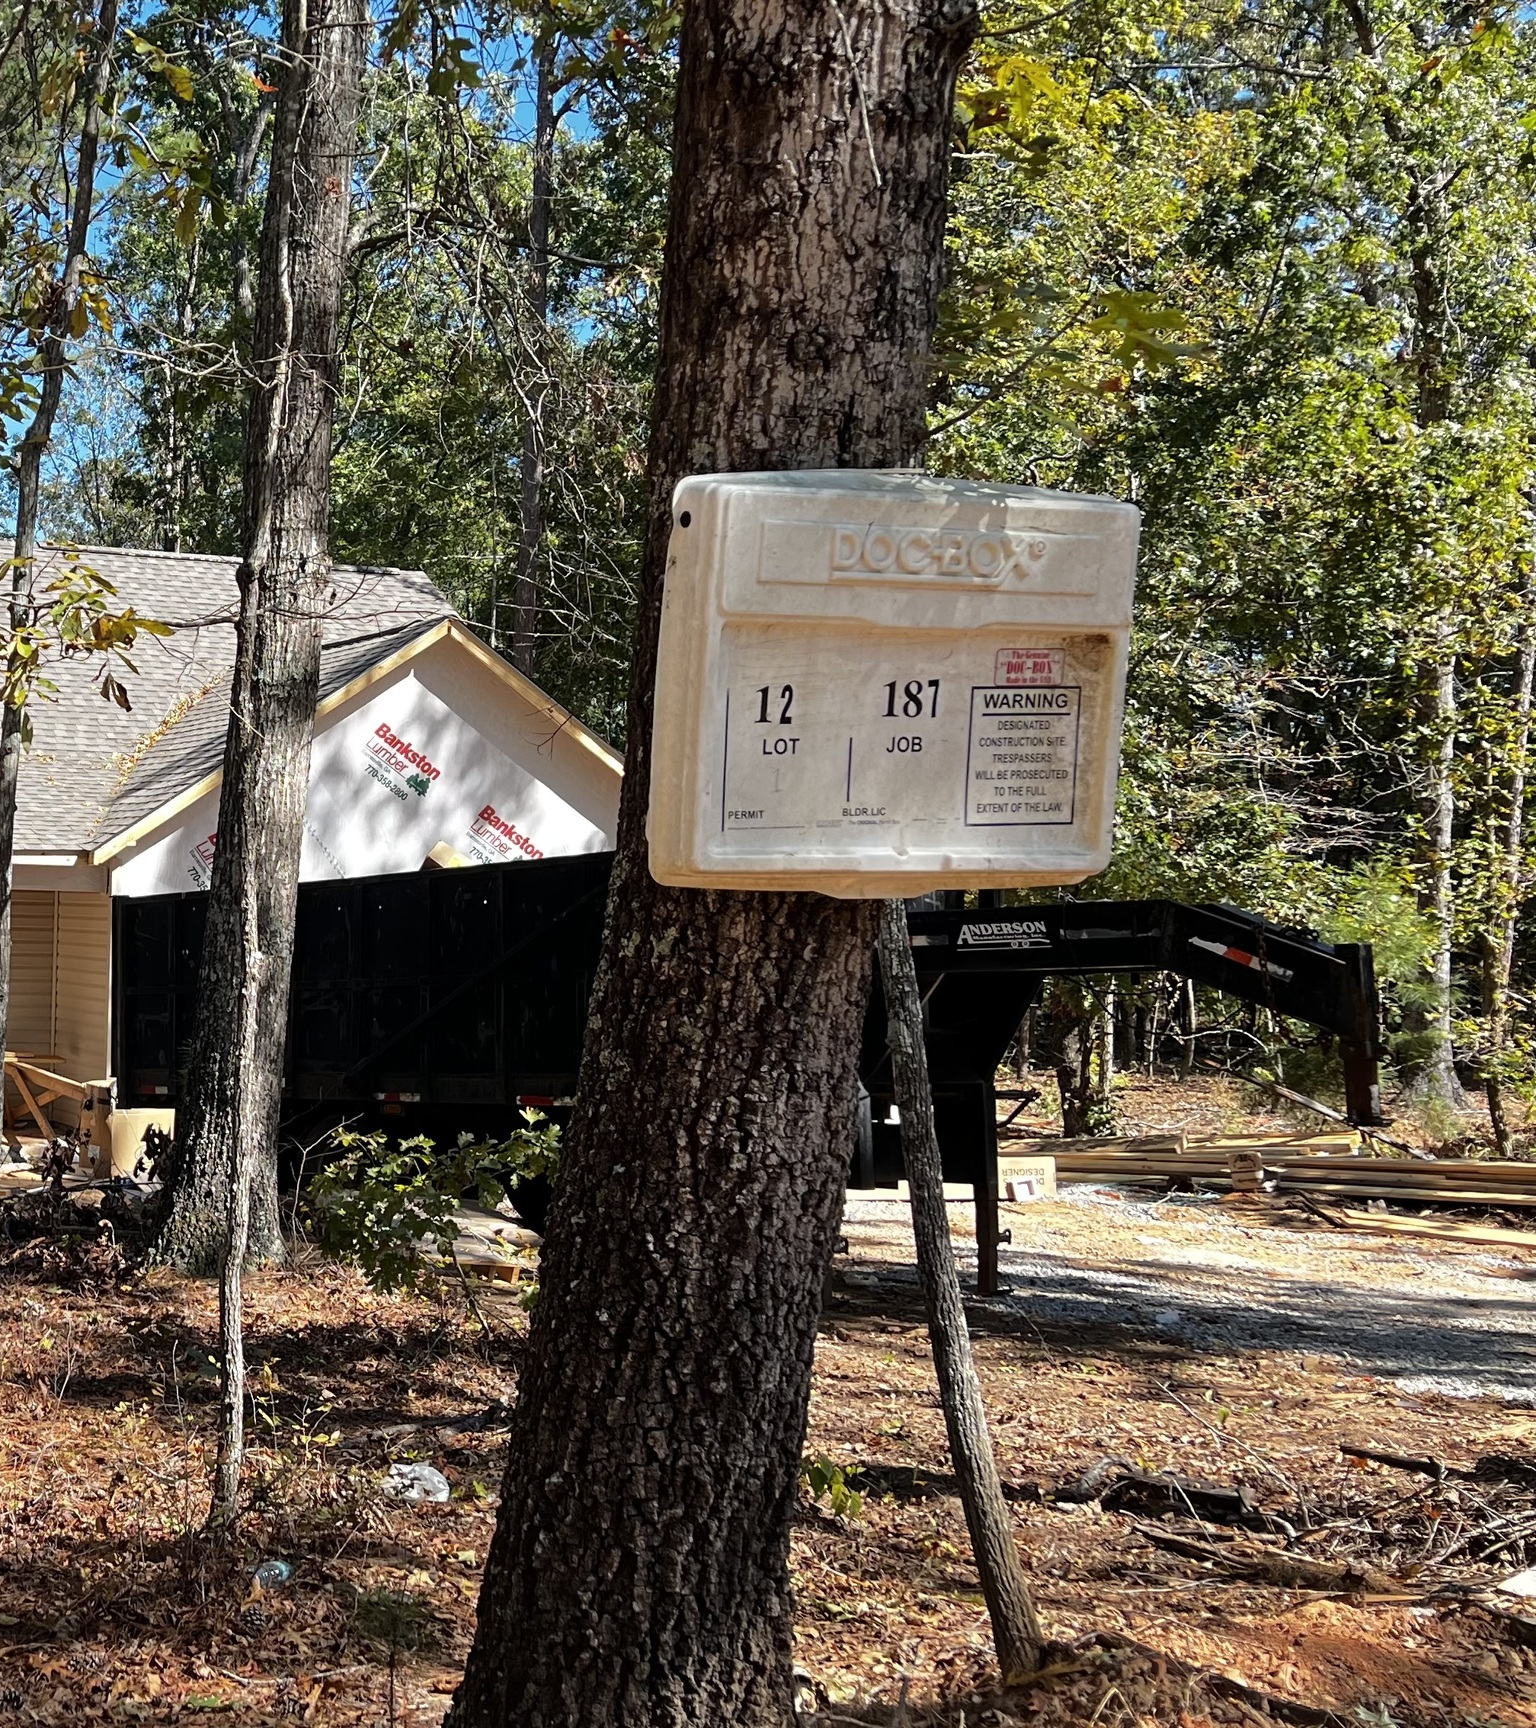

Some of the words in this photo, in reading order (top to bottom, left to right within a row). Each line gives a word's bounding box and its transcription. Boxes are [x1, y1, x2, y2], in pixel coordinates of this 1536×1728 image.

[754, 684, 794, 725] 12
[881, 678, 940, 718] 187
[983, 693, 1069, 709] WARNING
[997, 720, 1051, 731] DESIGNATED
[762, 738, 800, 755] LOT
[886, 736, 923, 753] JOB
[979, 737, 1044, 748] CONSTRUCTION
[365, 735, 409, 772] Lumber
[374, 722, 441, 781] Bankston
[992, 753, 1053, 763] TRESPASSERS
[364, 763, 409, 801] 770-358-2800
[975, 770, 994, 780] WILL
[997, 770, 1008, 779] BE
[1010, 769, 1069, 780] PROSECUTED
[994, 786, 1005, 796] TO
[1007, 786, 1024, 796] THE
[1026, 786, 1047, 796] FULL
[728, 810, 765, 820] PERMIT
[976, 803, 1009, 813] EXTENT
[1010, 803, 1023, 813] OF
[1025, 803, 1041, 812] THE
[470, 817, 512, 855] Lumber
[477, 804, 544, 859] Bankston
[956, 920, 1047, 945] ANDERSON
[1001, 1168, 1045, 1176] DESIGNER
